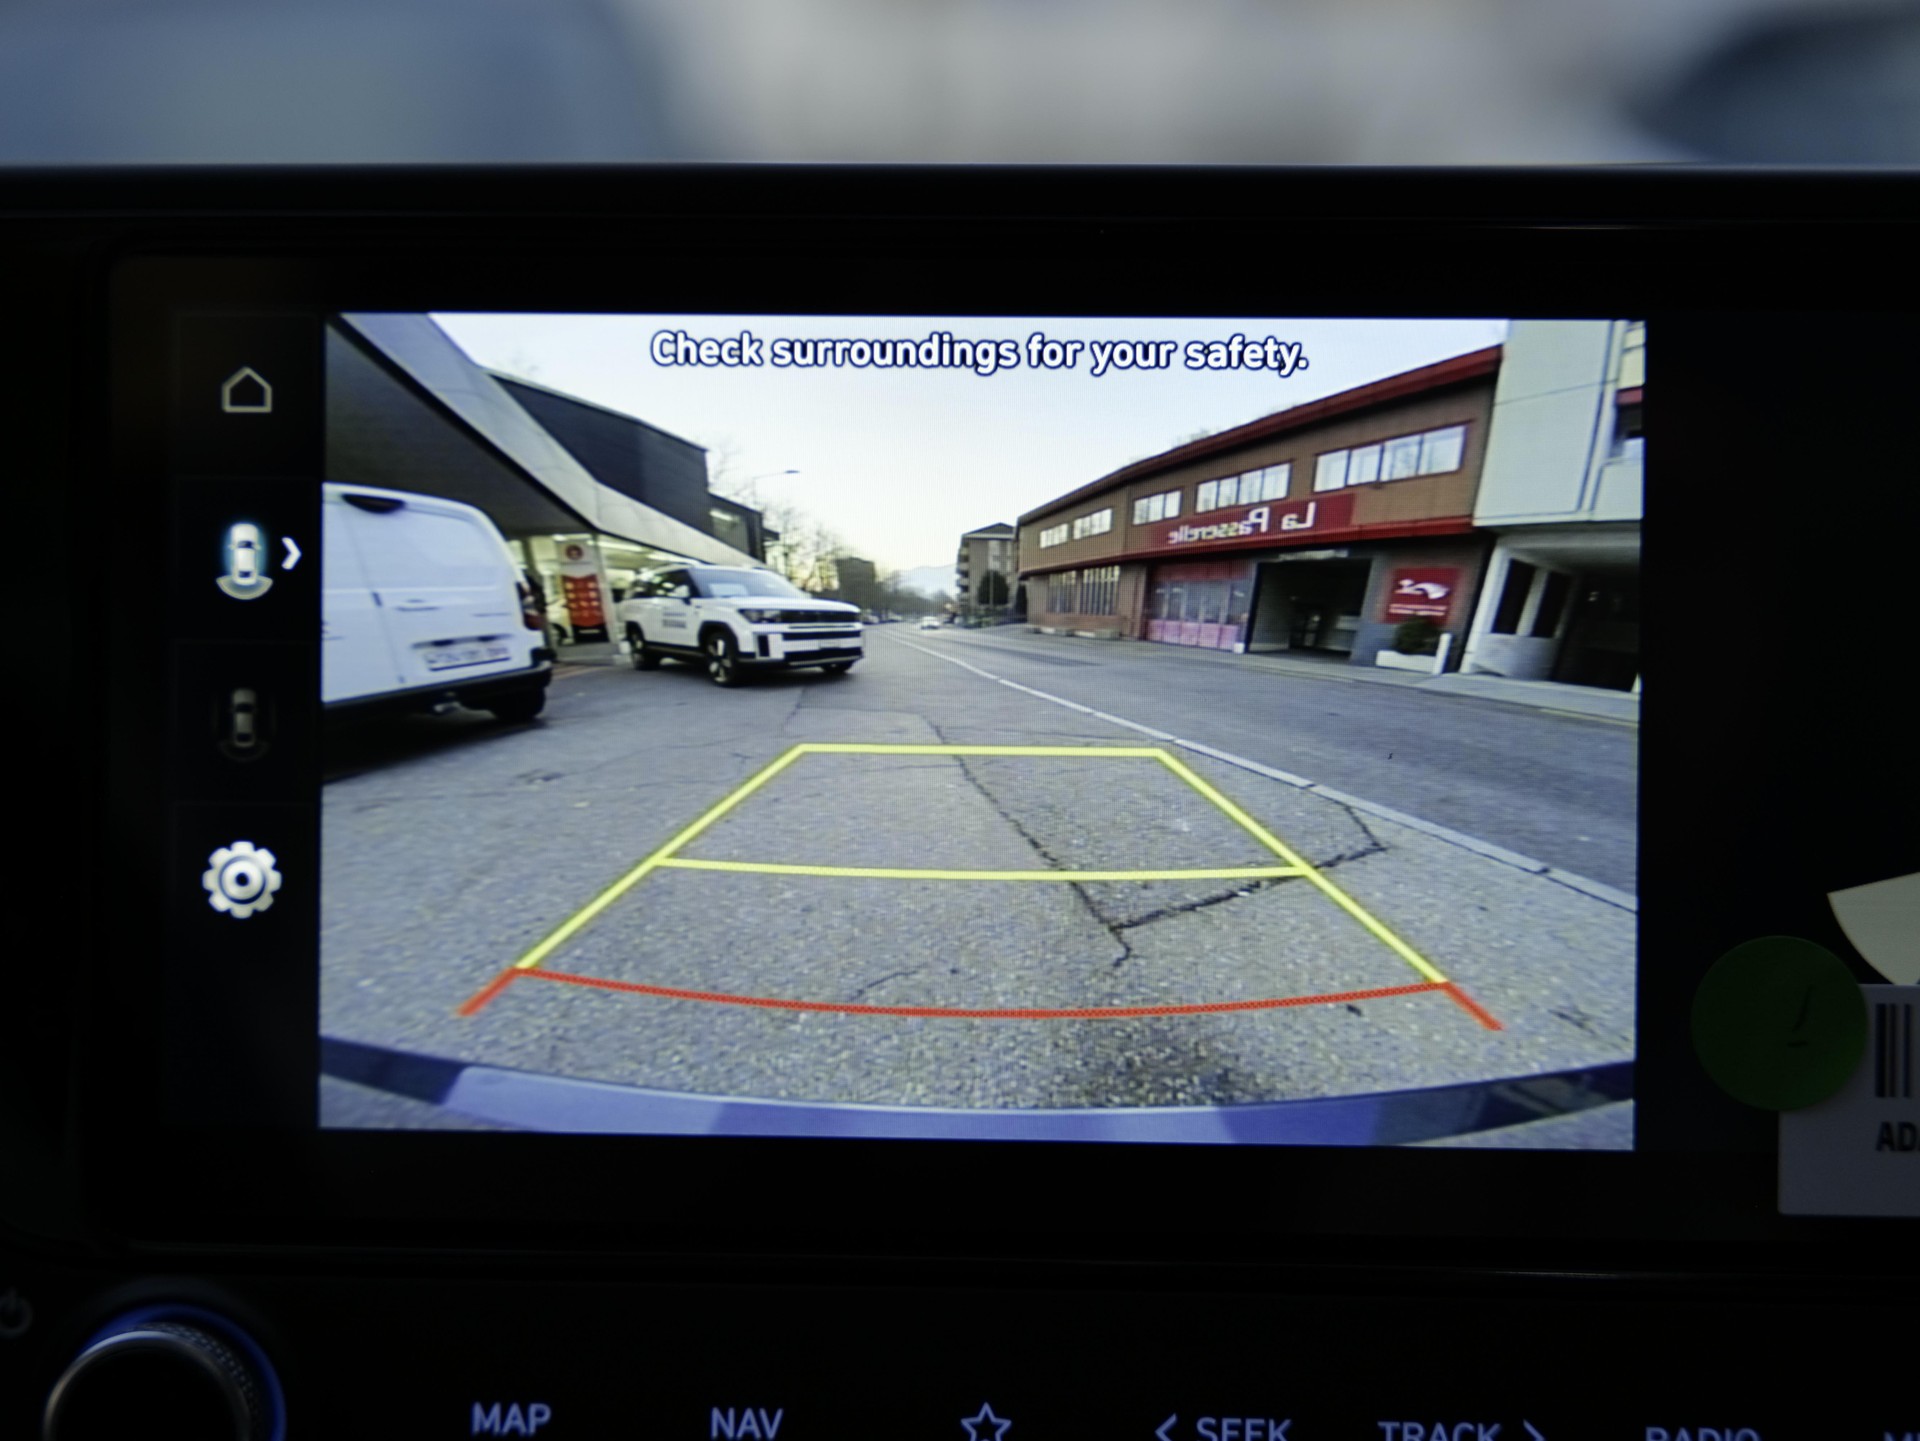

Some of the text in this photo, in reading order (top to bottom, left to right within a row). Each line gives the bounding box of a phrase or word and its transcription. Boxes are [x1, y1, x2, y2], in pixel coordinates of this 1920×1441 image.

[651, 330, 1309, 378] Check surroundings for your safety.
[1875, 1121, 1920, 1152] AD
[471, 1401, 552, 1436] MAP
[710, 1406, 784, 1440] NAV
[1195, 1416, 1293, 1441] SEEK
[1376, 1420, 1505, 1441] TRACK
